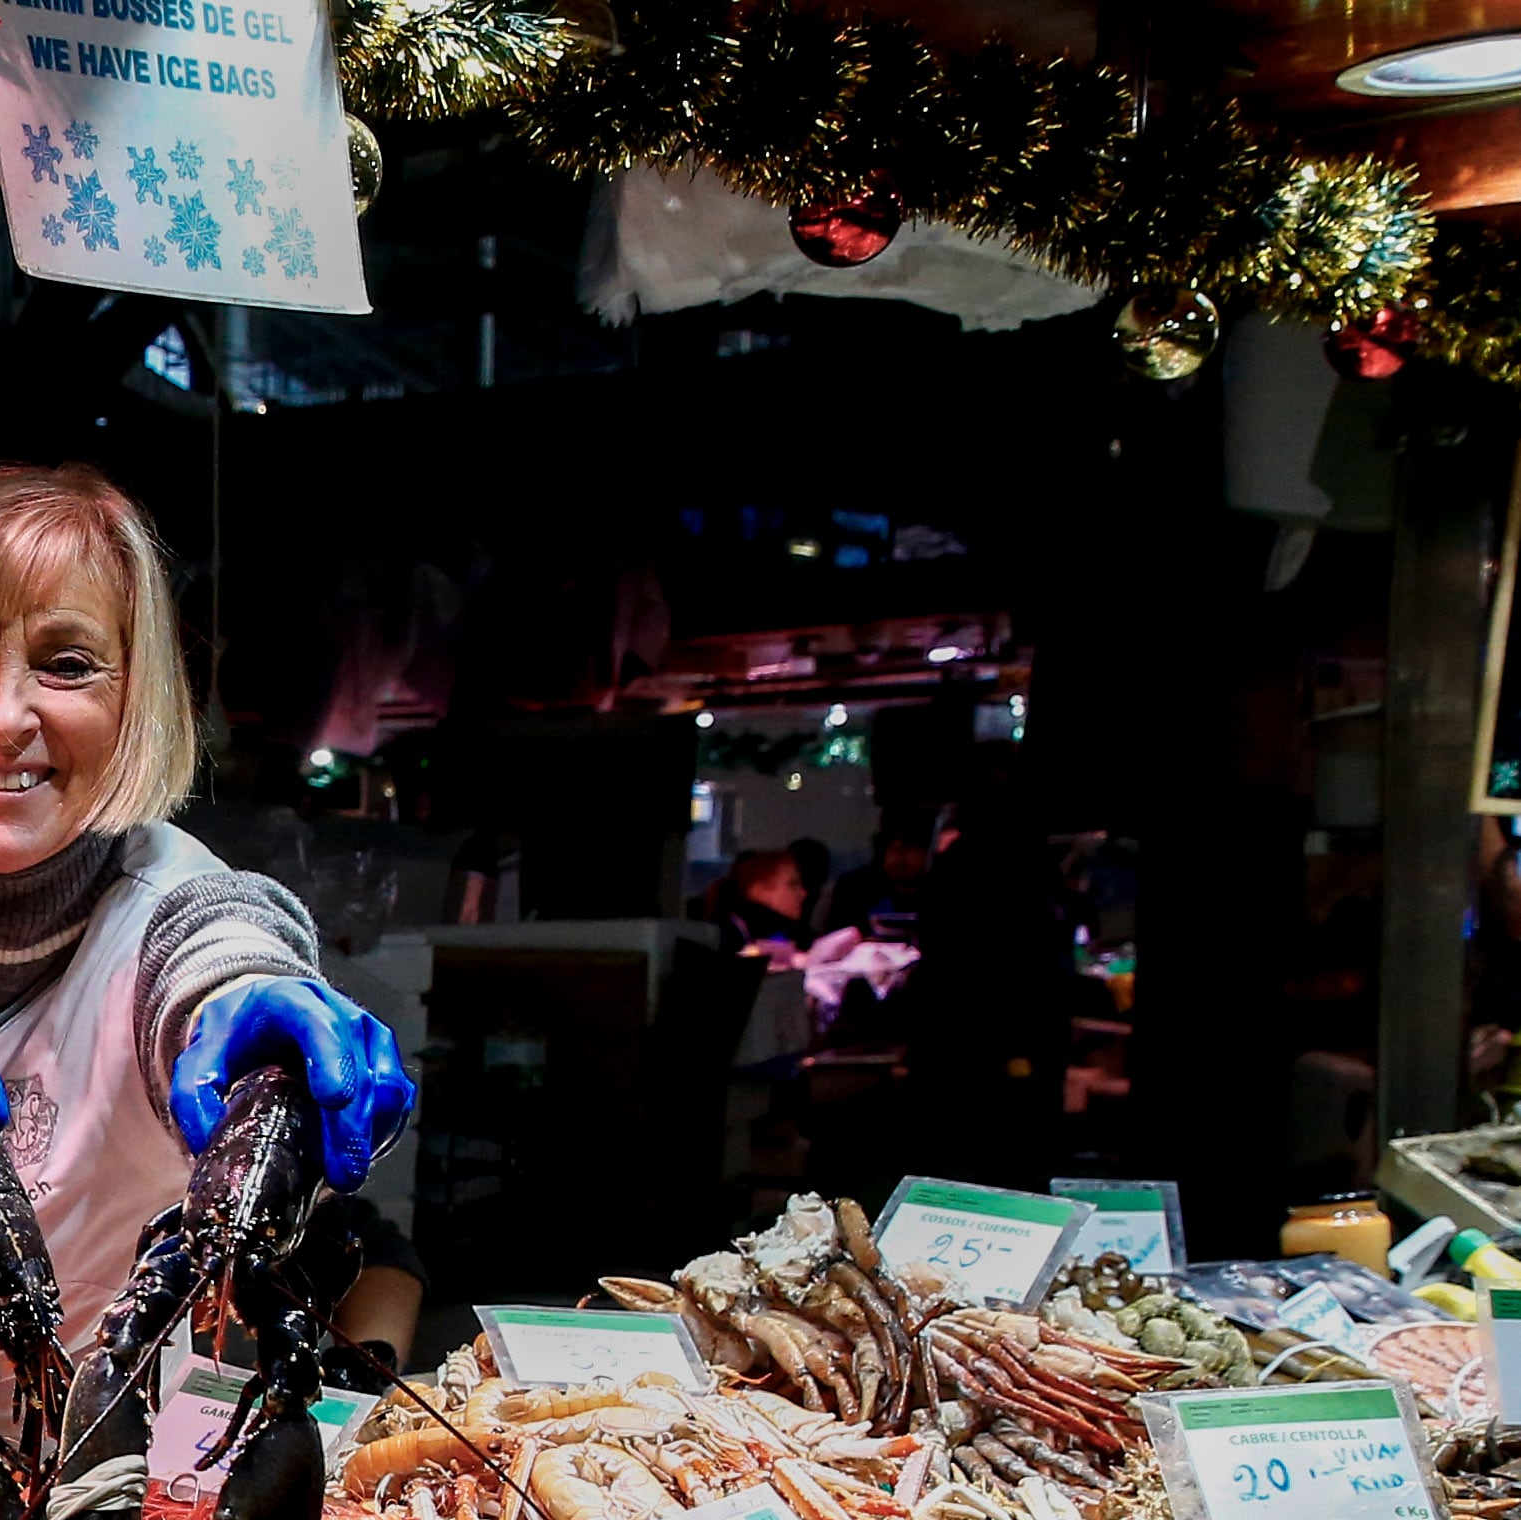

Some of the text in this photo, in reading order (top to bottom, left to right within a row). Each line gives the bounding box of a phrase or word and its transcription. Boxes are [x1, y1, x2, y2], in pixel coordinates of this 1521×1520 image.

[93, 0, 195, 31] BOSSES
[203, 4, 237, 36] DE
[244, 9, 294, 45] GEL
[27, 35, 277, 99] WE HAVE ICE BAGS
[921, 1212, 966, 1227] COSSOS
[1229, 1431, 1279, 1446] CABRE
[1290, 1428, 1367, 1442] CENTOLLA
